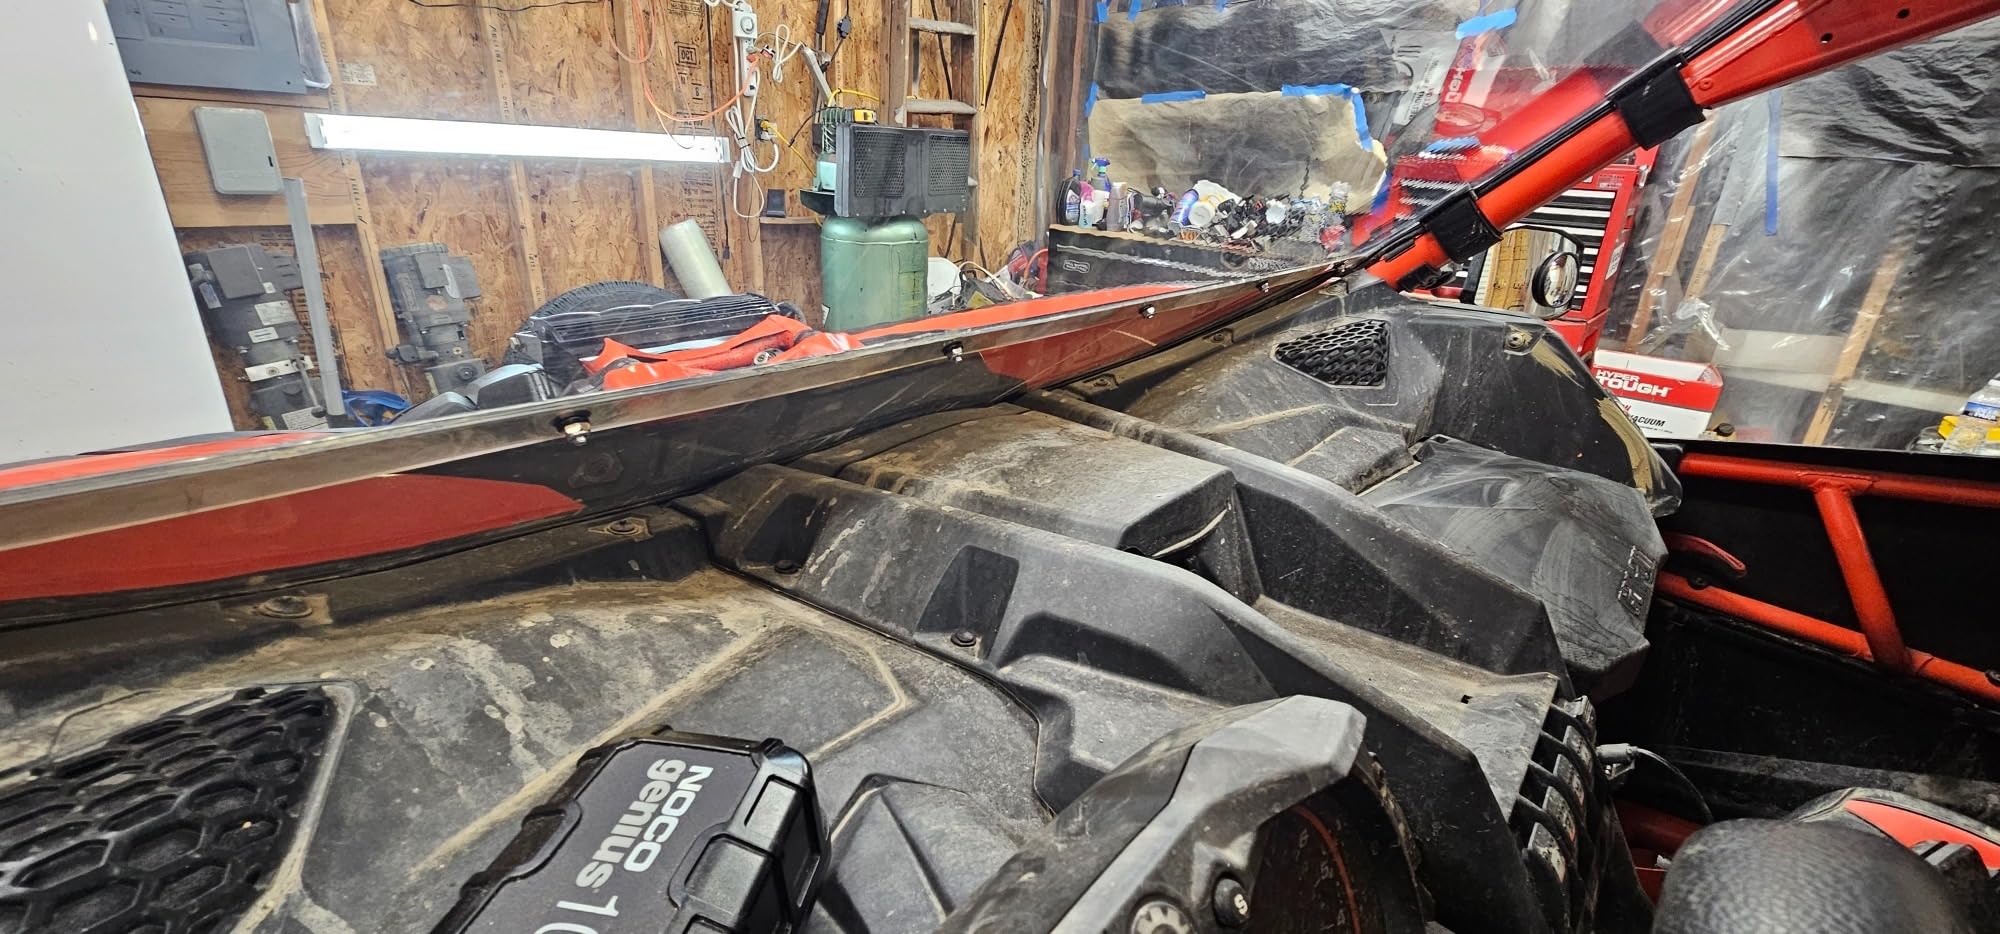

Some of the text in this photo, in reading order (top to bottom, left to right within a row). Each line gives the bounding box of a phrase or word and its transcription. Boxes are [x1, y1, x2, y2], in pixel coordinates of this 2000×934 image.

[1597, 369, 1640, 382] HYPER
[1596, 376, 1669, 397] TOUGH
[575, 758, 687, 889] genius
[623, 765, 714, 873] NOCO
[1235, 894, 1249, 914] S
